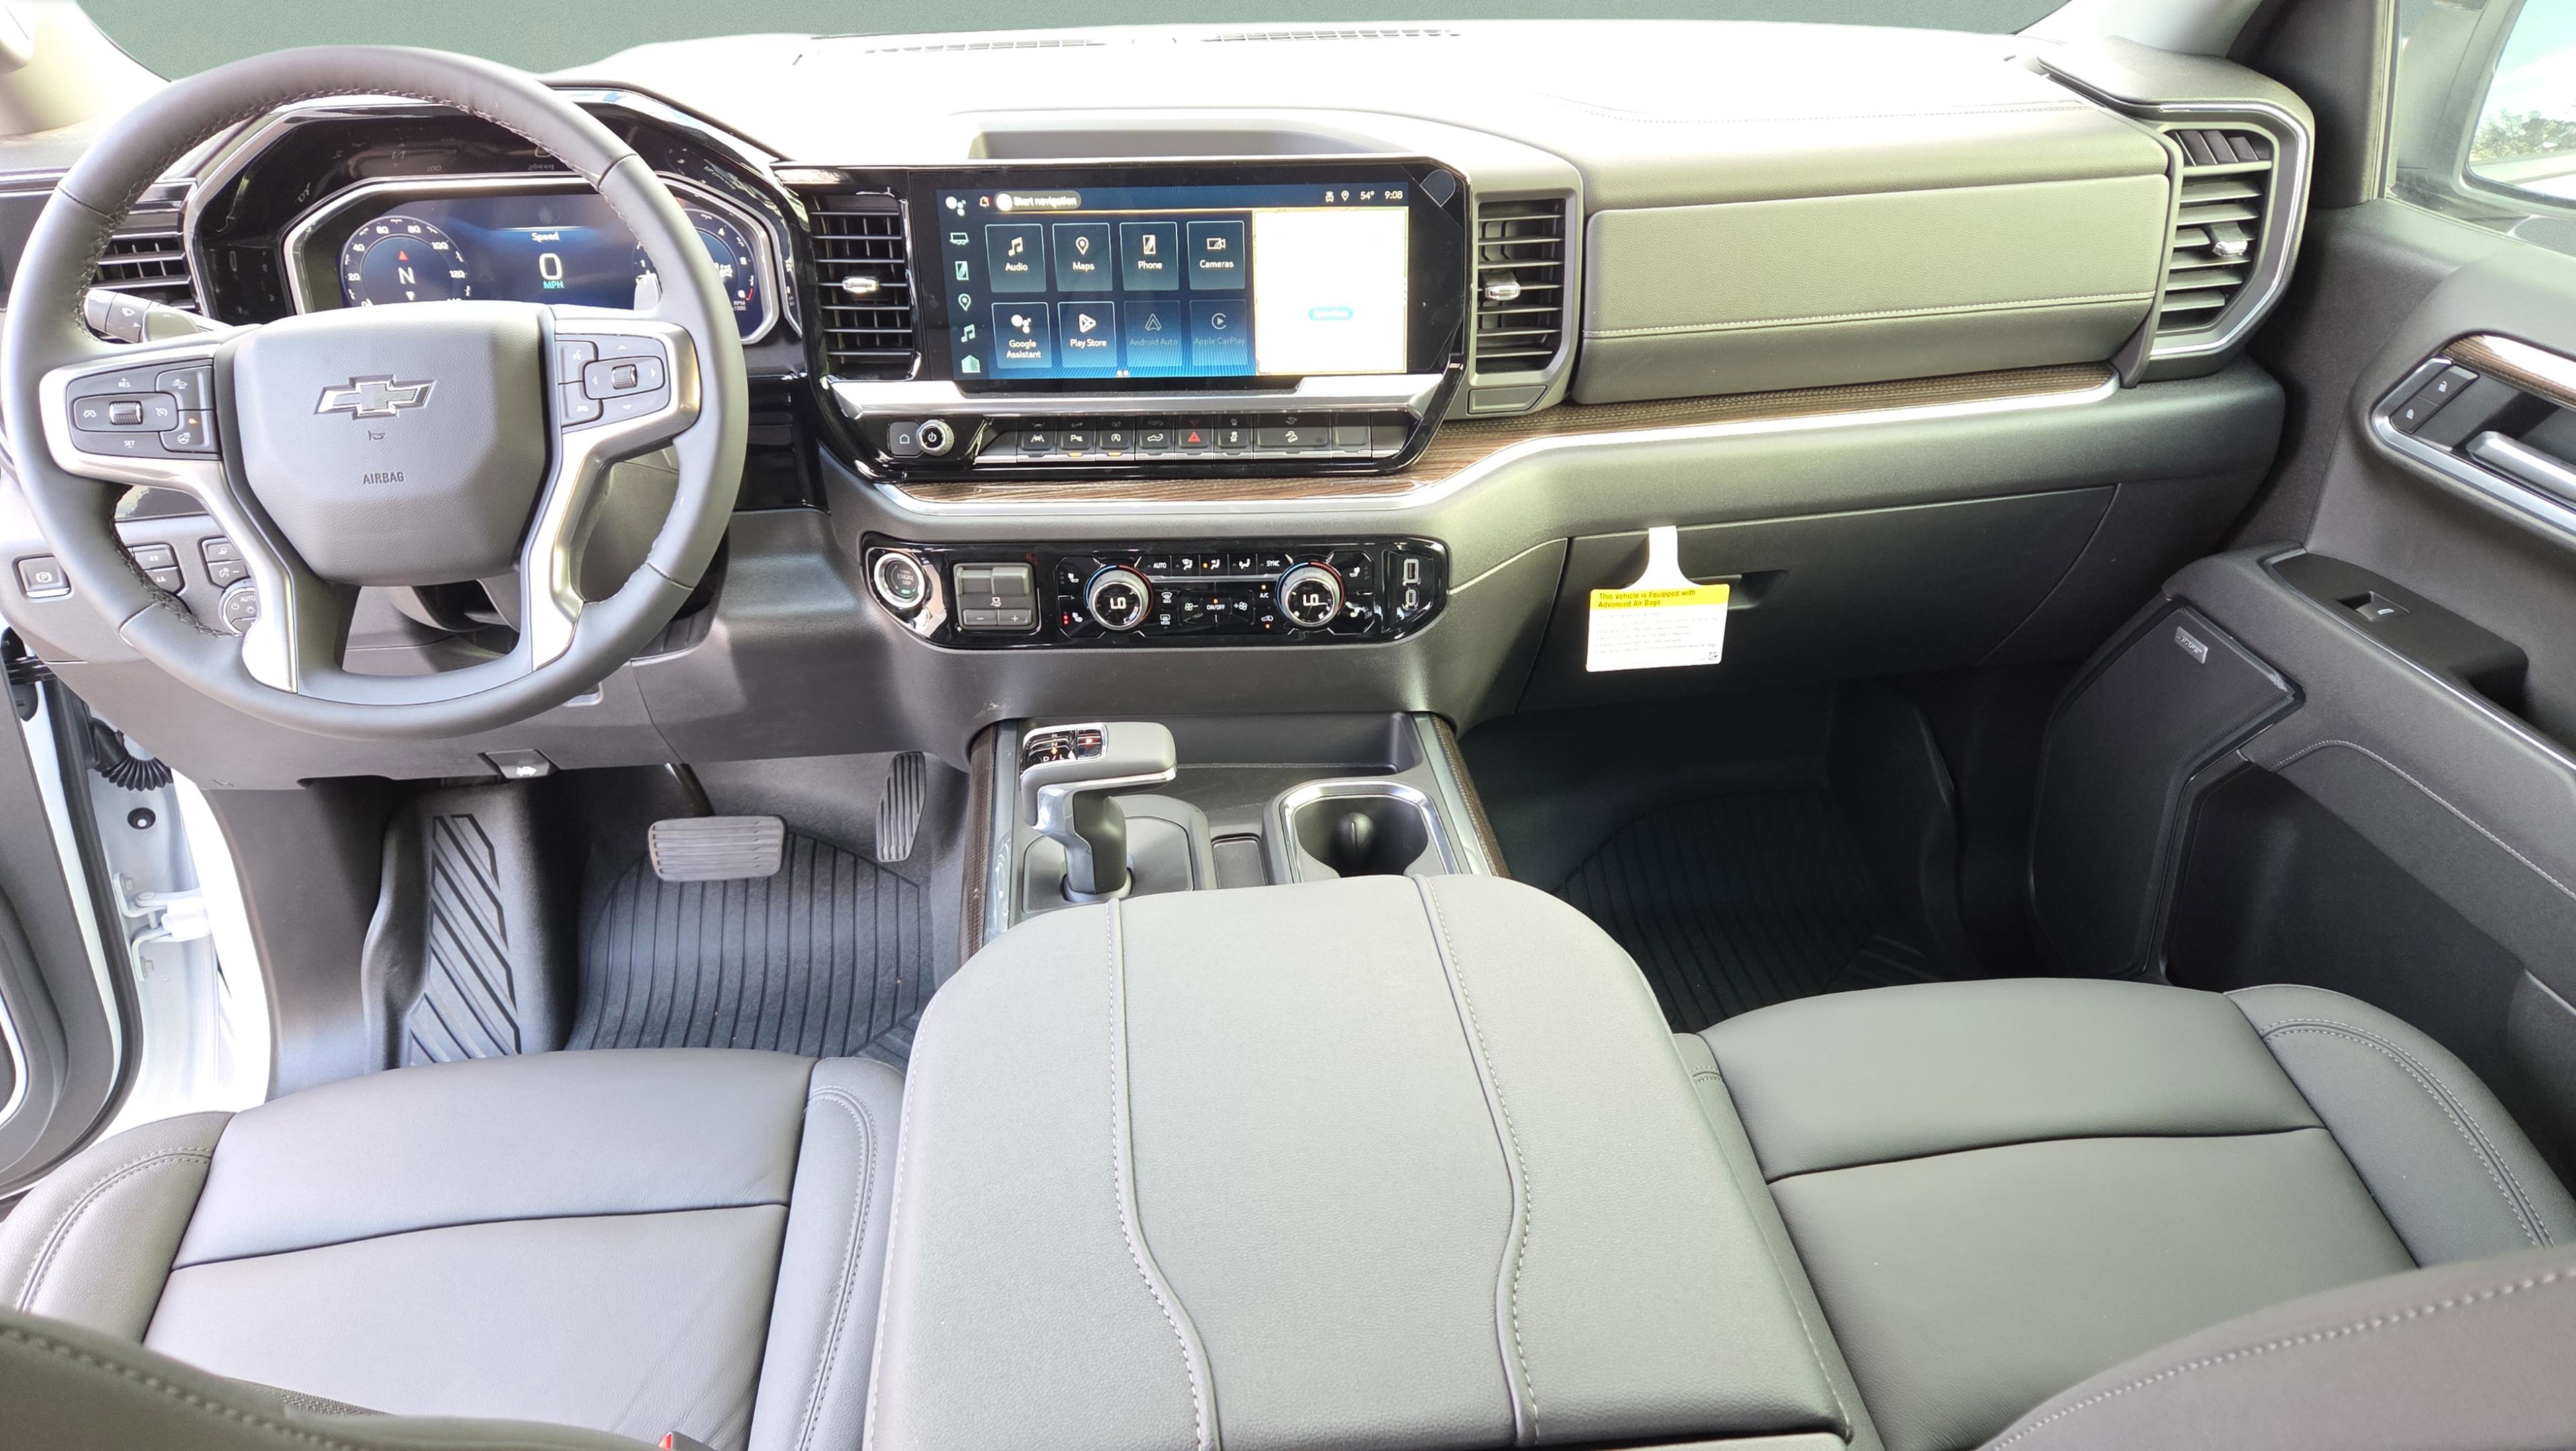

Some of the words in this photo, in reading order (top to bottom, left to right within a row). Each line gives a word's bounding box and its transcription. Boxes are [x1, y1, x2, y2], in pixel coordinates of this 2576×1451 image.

[1384, 190, 1404, 200] 9:08
[1013, 196, 1033, 206] Start
[1035, 195, 1077, 208] navigation
[532, 231, 560, 243] Speed
[431, 241, 449, 250] 100
[539, 253, 562, 280] 0
[1005, 263, 1028, 271] Audio
[1072, 262, 1095, 271] Maps
[1138, 261, 1162, 269] Phone
[1199, 259, 1234, 269] Cameras
[348, 273, 360, 281] 20
[398, 267, 416, 284] N
[543, 280, 564, 290] MPH
[1009, 339, 1037, 349] Google
[1070, 339, 1086, 349] Play
[1087, 339, 1107, 347] Store
[1130, 338, 1159, 346] Android
[1194, 338, 1215, 347] Apple
[1216, 337, 1246, 347] CarPlay
[1006, 350, 1041, 359] Assistant
[363, 472, 404, 484] AIRBAG
[1615, 592, 1639, 600] Vehicle
[1649, 590, 1680, 600] Equipped
[1598, 600, 1631, 608] Advanced
